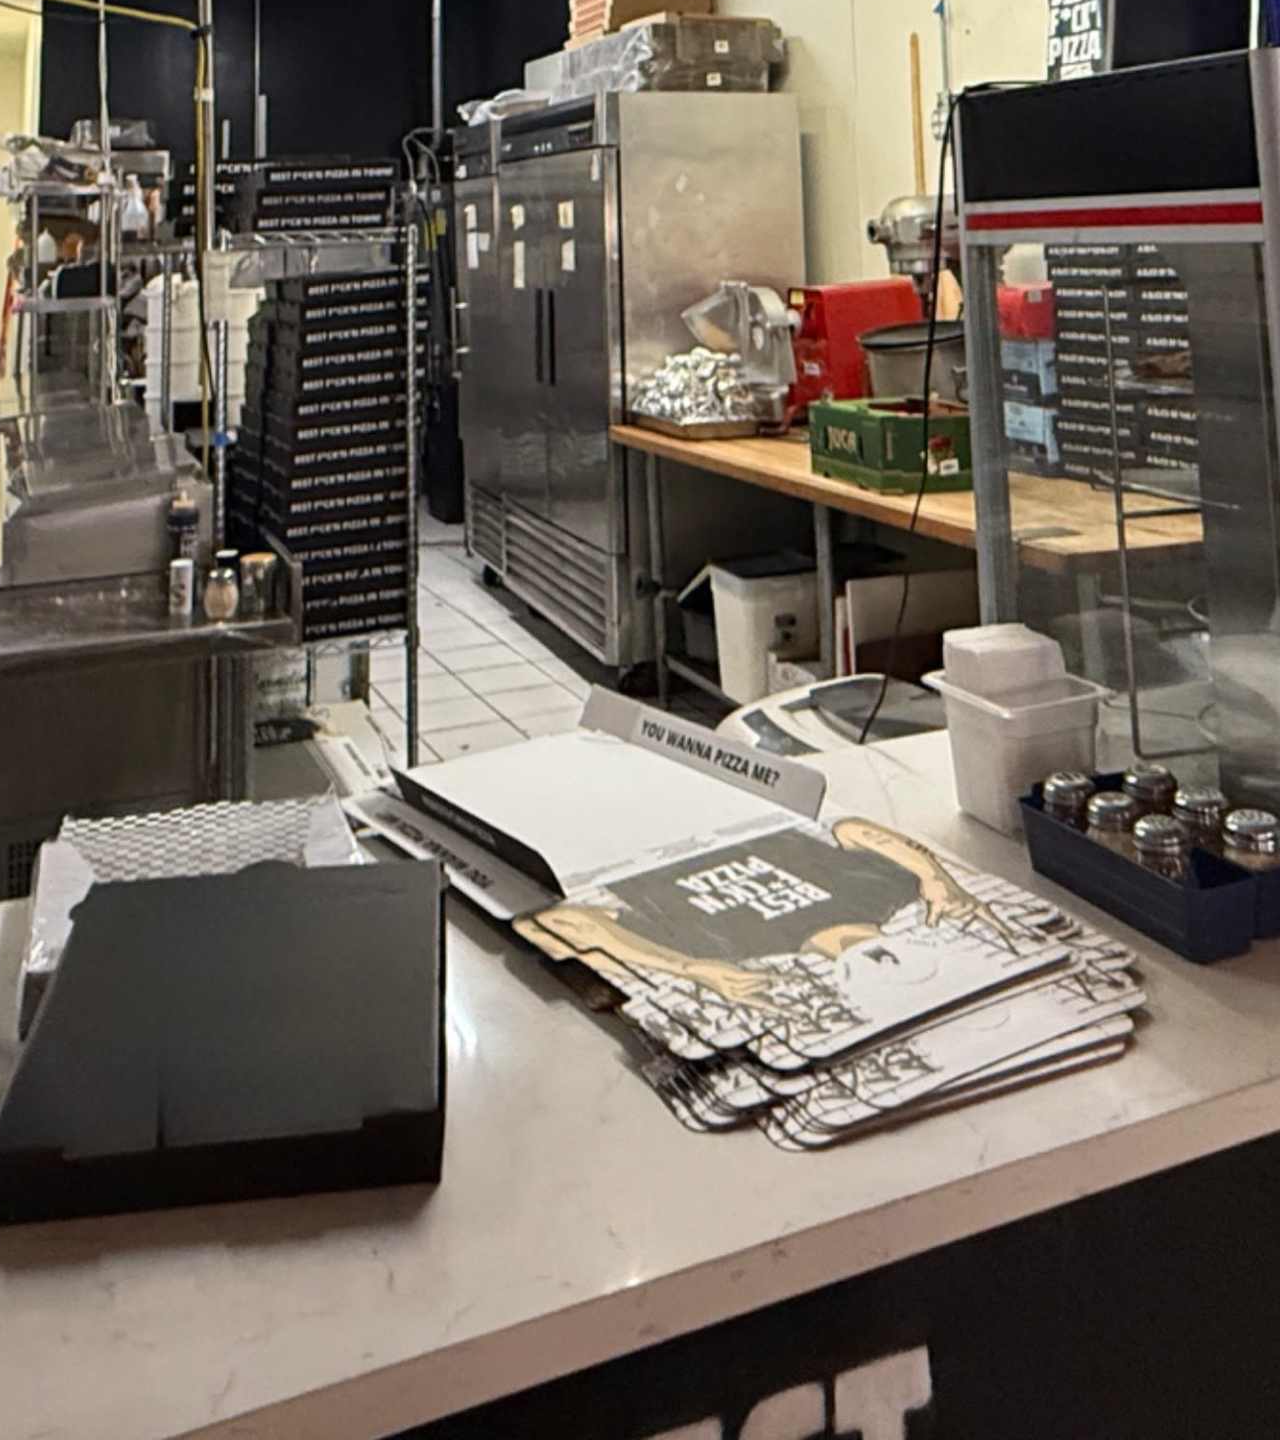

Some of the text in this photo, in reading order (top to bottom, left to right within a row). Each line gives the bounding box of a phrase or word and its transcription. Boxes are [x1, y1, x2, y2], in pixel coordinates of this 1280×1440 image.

[1048, 29, 1102, 66] PIZZA
[640, 719, 781, 787] YOU WANNA PIZZA ME?
[675, 855, 774, 893] PIZZA
[748, 881, 833, 921] BEST
